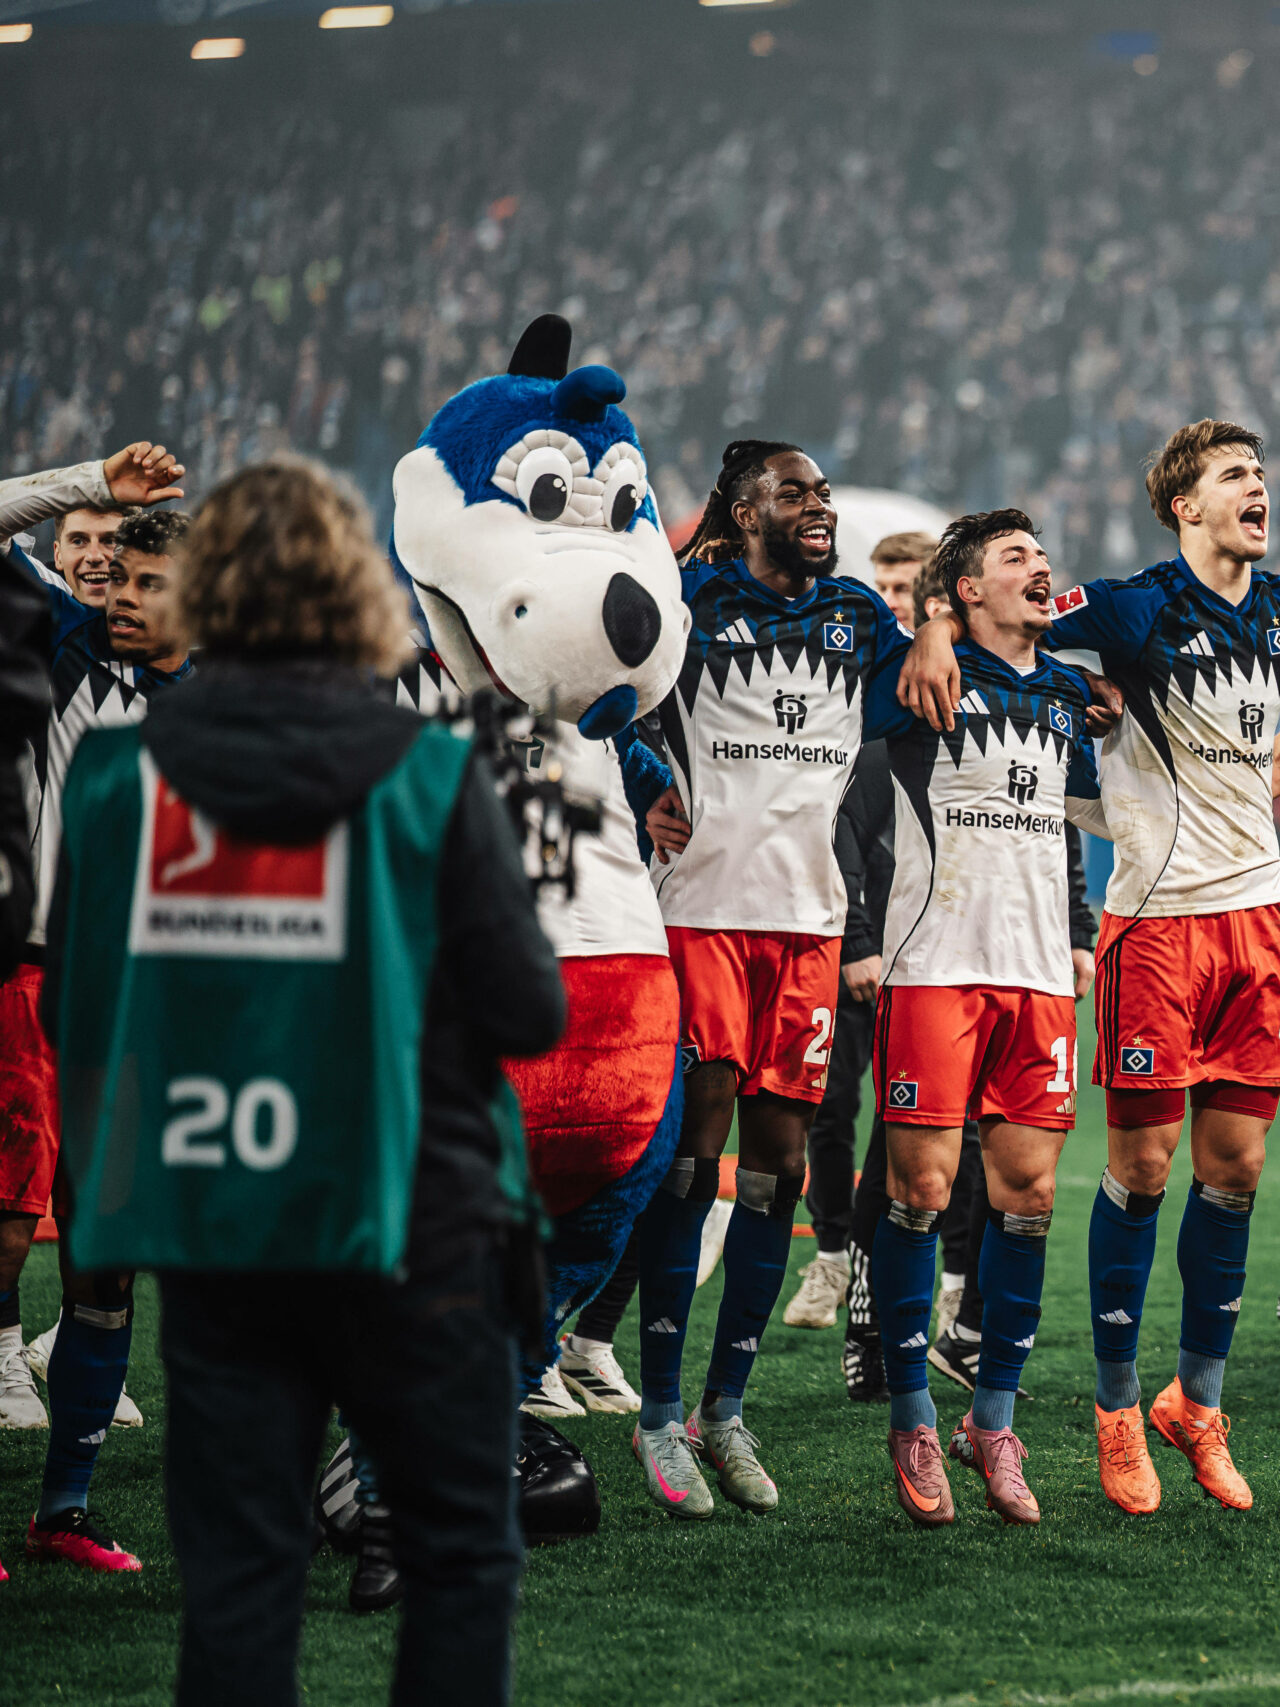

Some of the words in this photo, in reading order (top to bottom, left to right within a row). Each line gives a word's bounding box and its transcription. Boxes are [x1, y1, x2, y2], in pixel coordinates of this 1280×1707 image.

[712, 741, 848, 767] HanseMerkur
[803, 1007, 837, 1065] 2
[161, 1074, 299, 1172] 20
